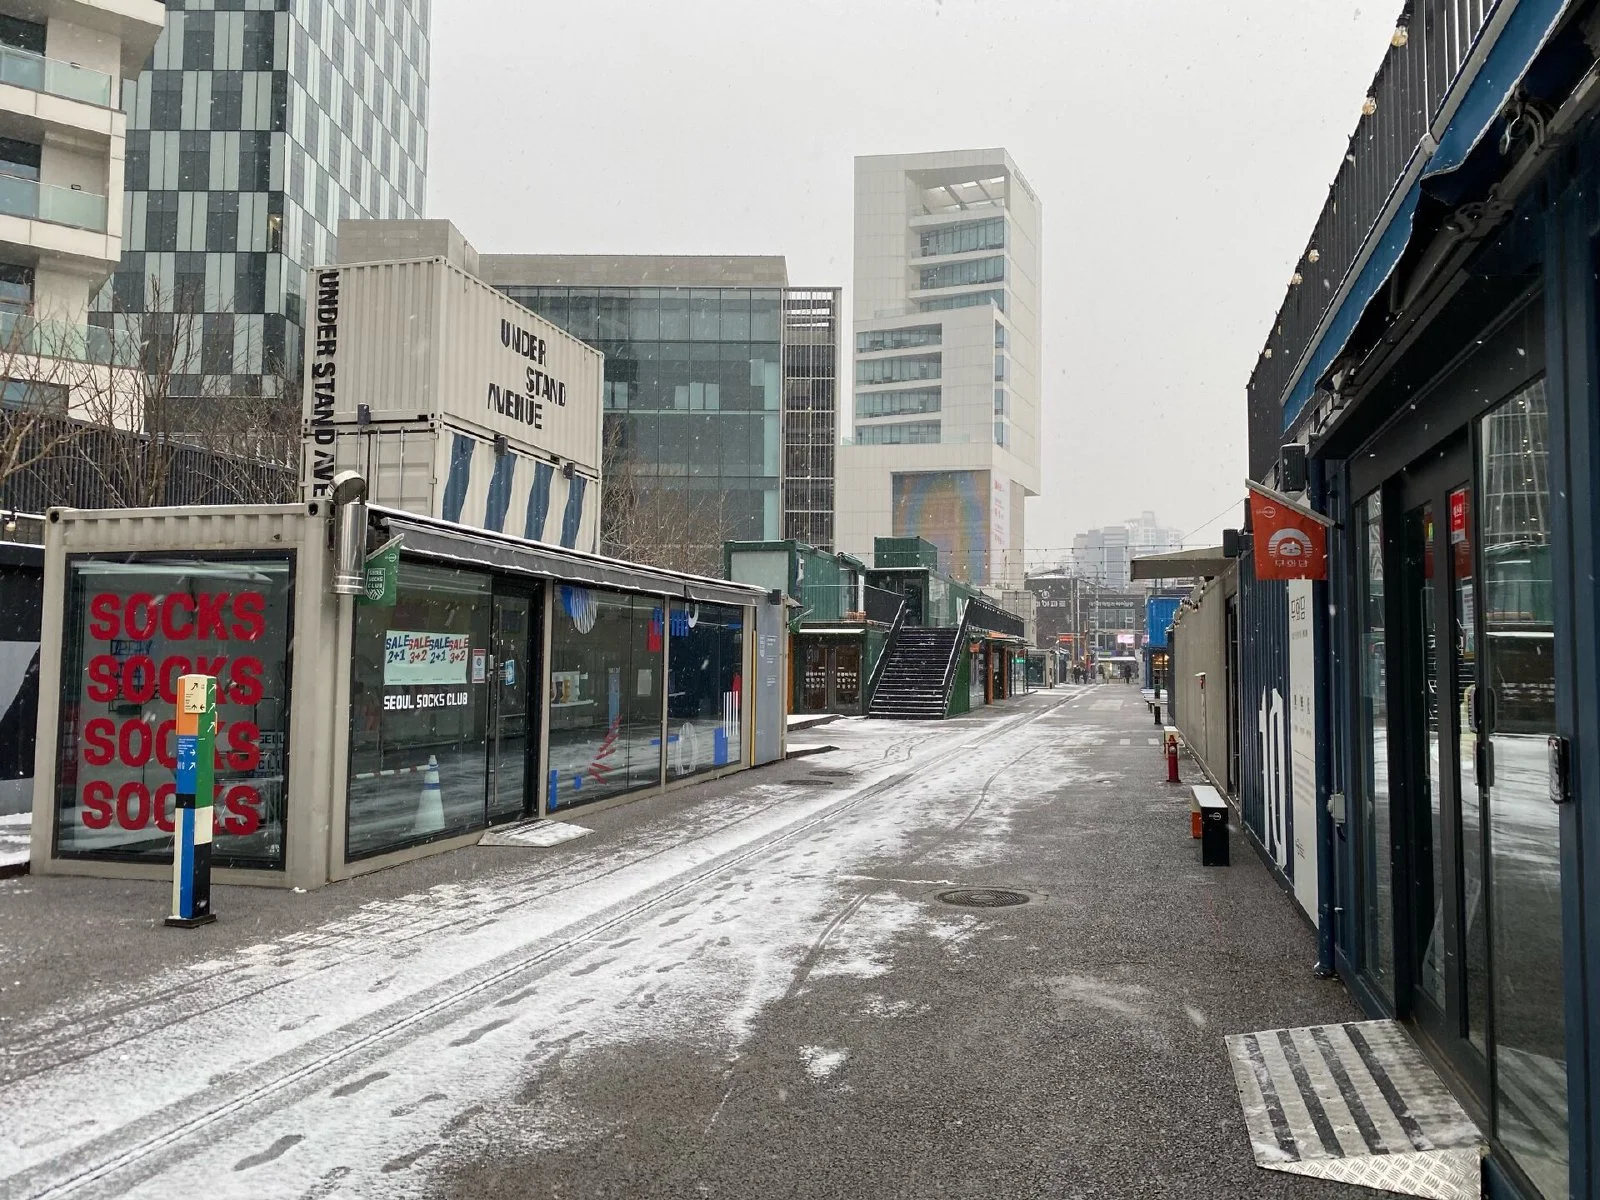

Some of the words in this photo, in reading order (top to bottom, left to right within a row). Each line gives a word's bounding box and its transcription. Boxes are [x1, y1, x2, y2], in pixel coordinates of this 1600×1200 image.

[317, 272, 339, 356] UNDER
[501, 318, 547, 367] UNDER
[311, 362, 336, 445] STAND
[487, 382, 543, 429] AVENUE
[526, 366, 566, 407] STAND
[89, 592, 266, 641] SOCKS
[386, 634, 410, 650] SALE
[408, 636, 431, 650] SALE
[429, 637, 450, 651] SALE
[448, 637, 469, 651] SALE
[387, 649, 405, 664] 2+1
[409, 649, 427, 664] 3+2
[430, 650, 446, 664] 2+1
[450, 650, 466, 664] 3+2
[383, 694, 415, 710] SEOUL
[416, 693, 445, 708] SOCKS
[446, 692, 468, 705] CLUB
[83, 718, 261, 771] SOCS
[81, 780, 262, 836] SOCS
